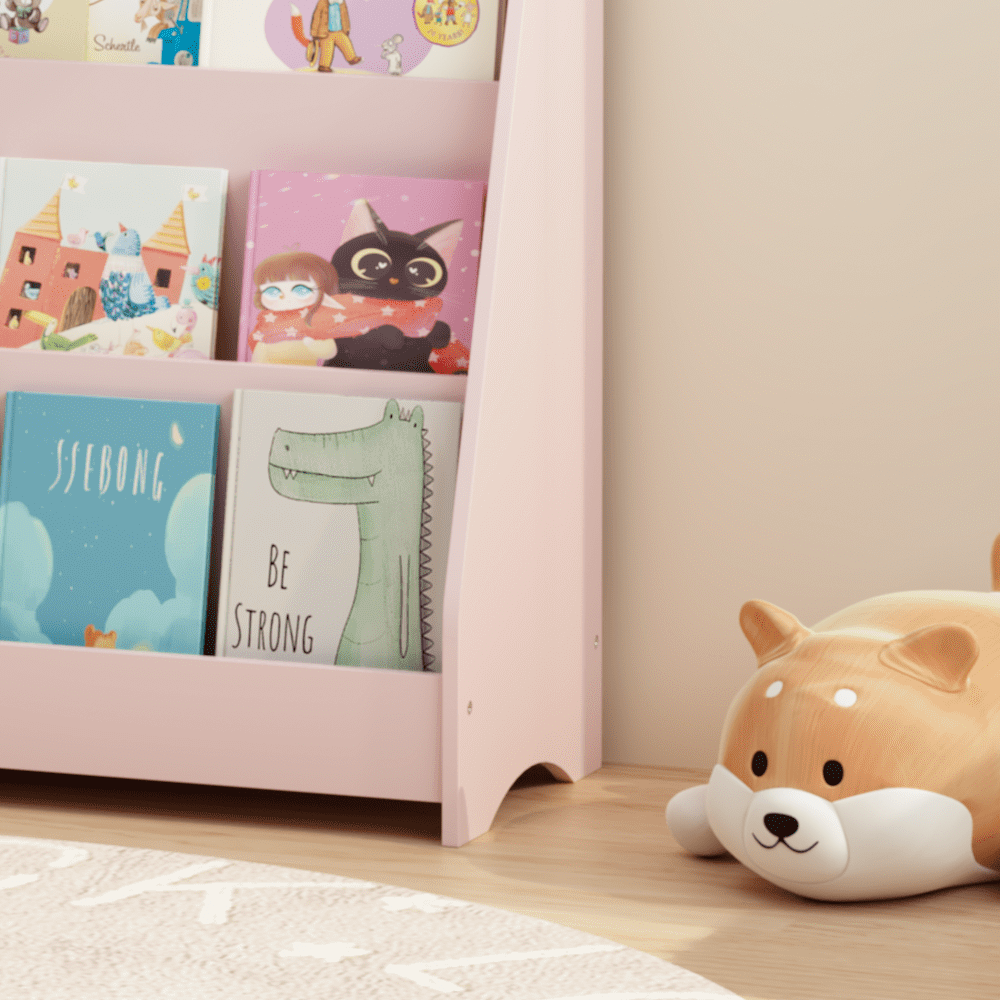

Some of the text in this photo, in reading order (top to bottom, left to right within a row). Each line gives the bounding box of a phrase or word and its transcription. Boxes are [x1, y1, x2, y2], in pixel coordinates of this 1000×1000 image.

[47, 438, 165, 502] SSEBONG
[267, 543, 290, 590] BE
[232, 602, 314, 655] STRONG
